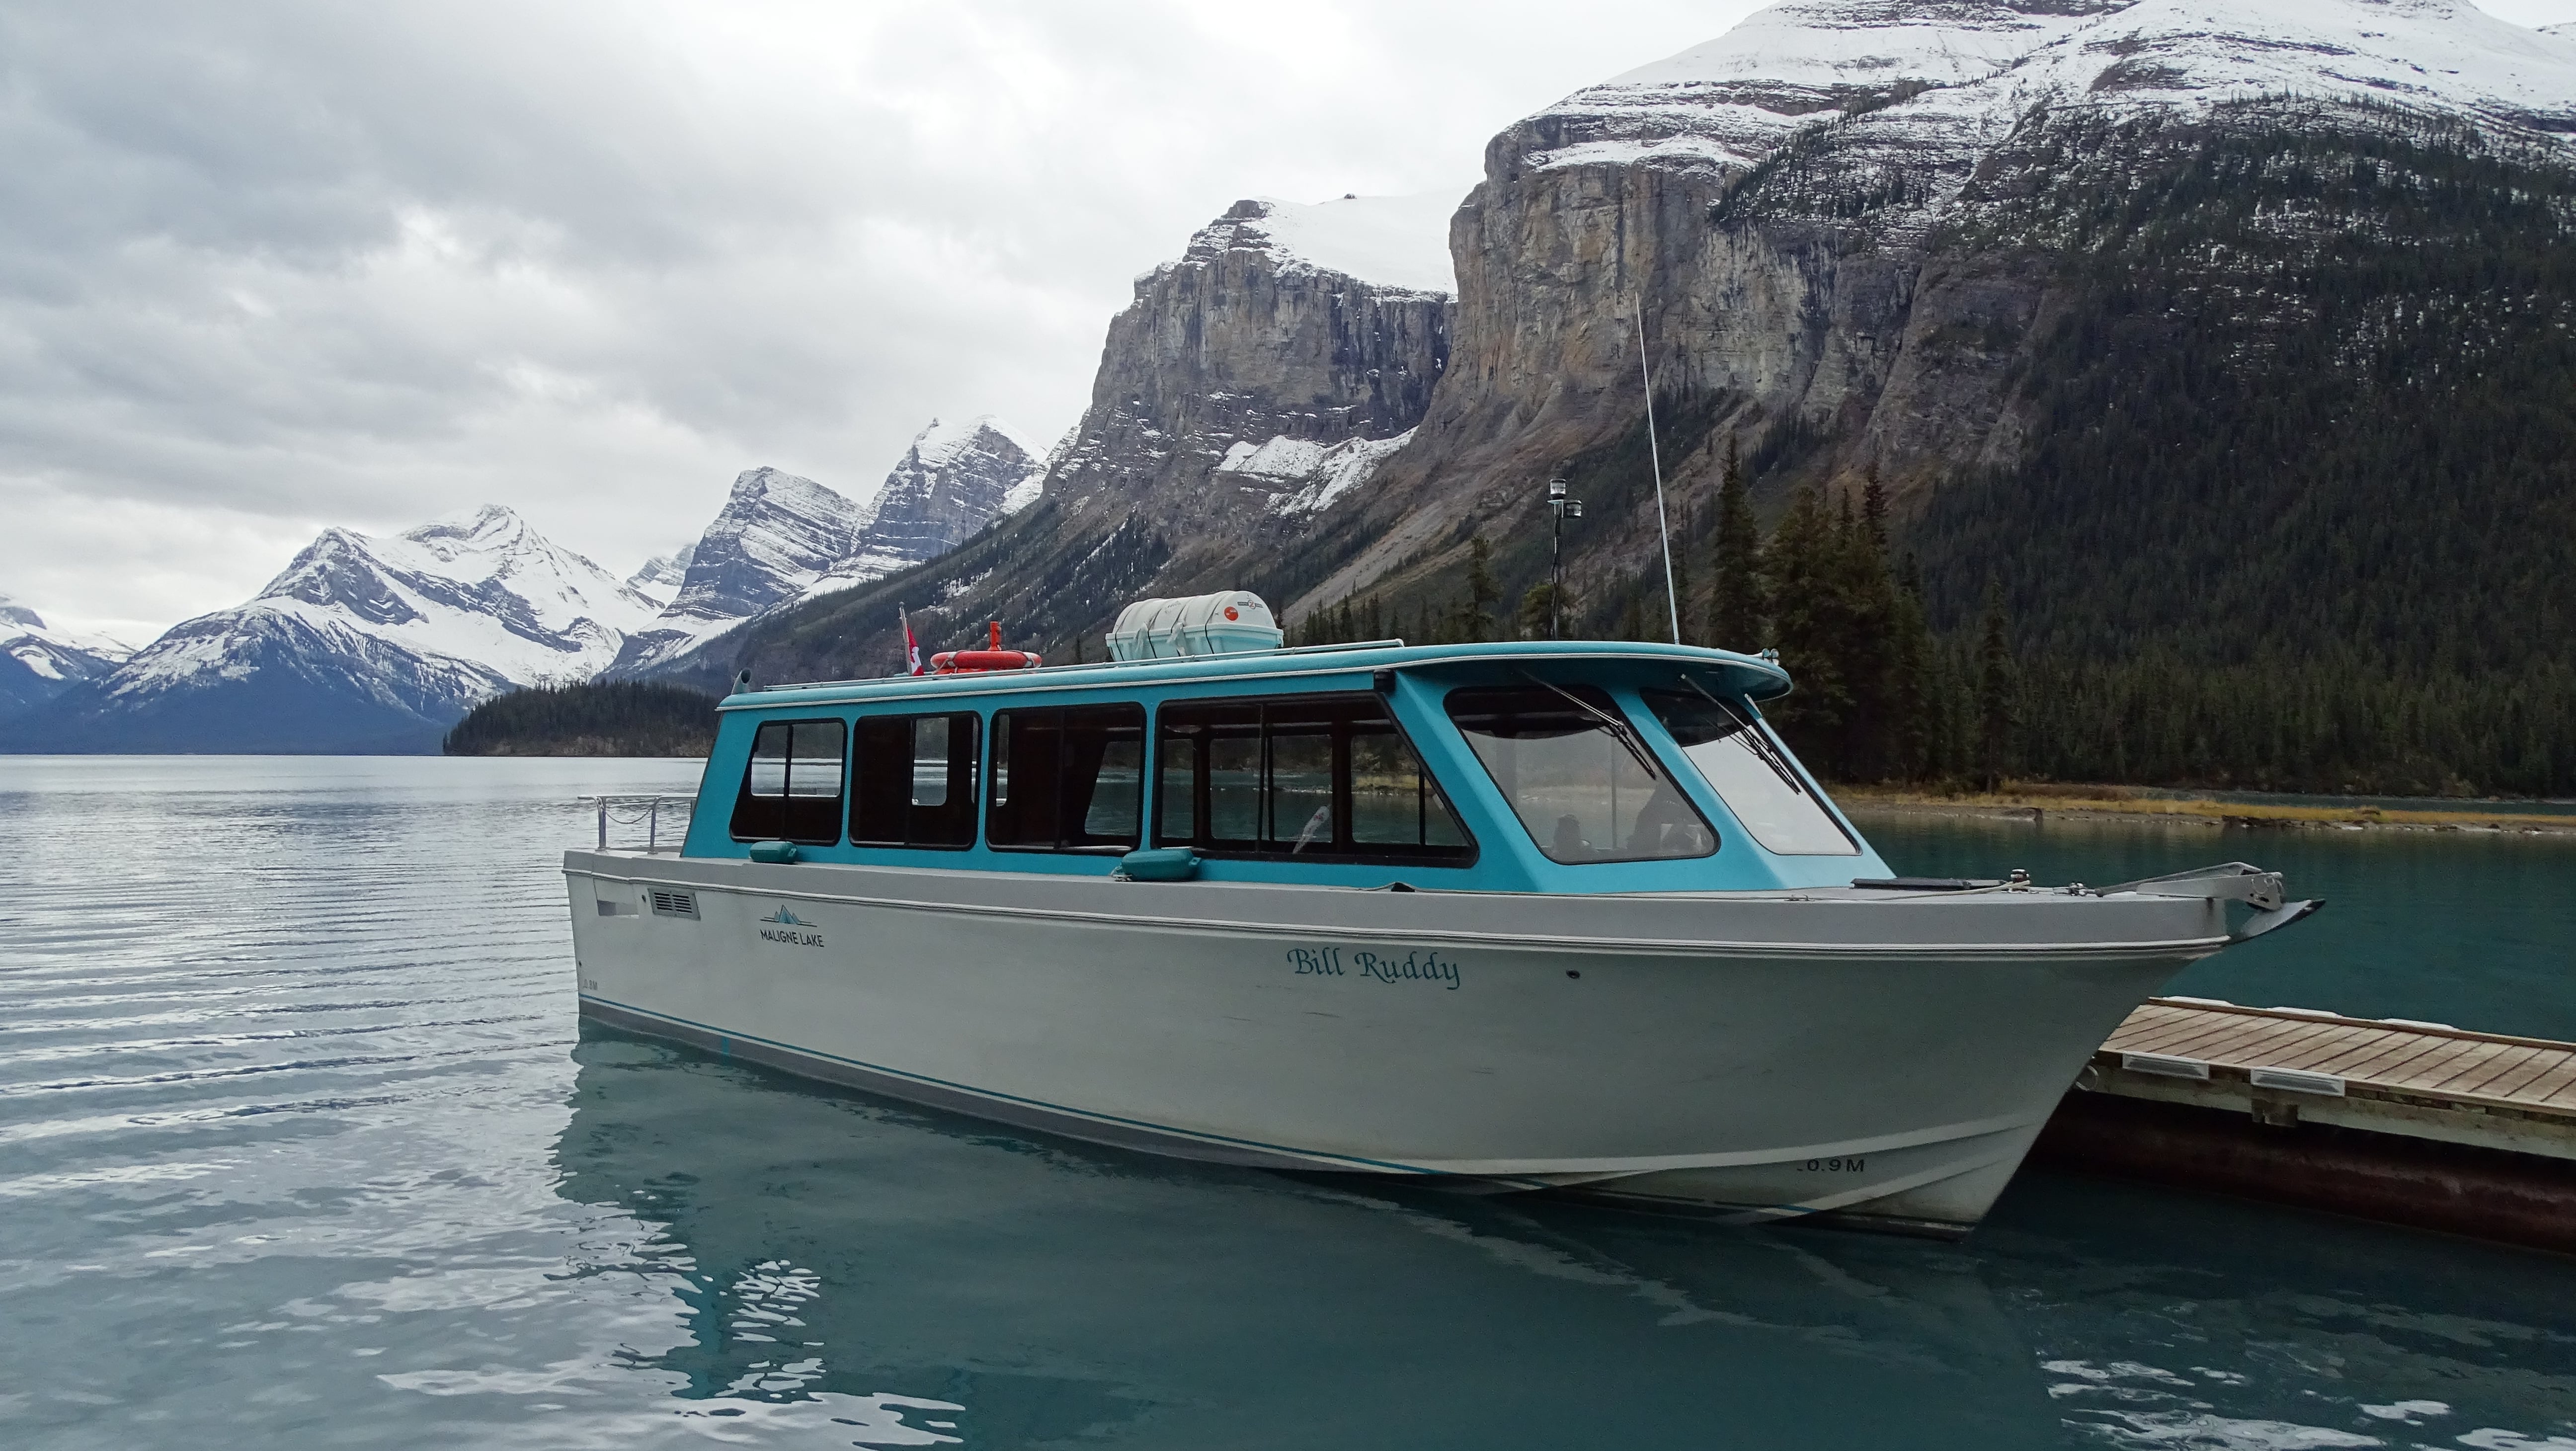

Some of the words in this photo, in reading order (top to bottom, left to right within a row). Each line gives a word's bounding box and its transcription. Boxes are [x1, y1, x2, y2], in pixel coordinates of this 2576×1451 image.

[760, 929, 799, 944] MALIGNE
[800, 933, 824, 947] LAKE
[1287, 947, 1346, 976] Bill
[1354, 951, 1461, 990] Ruddy
